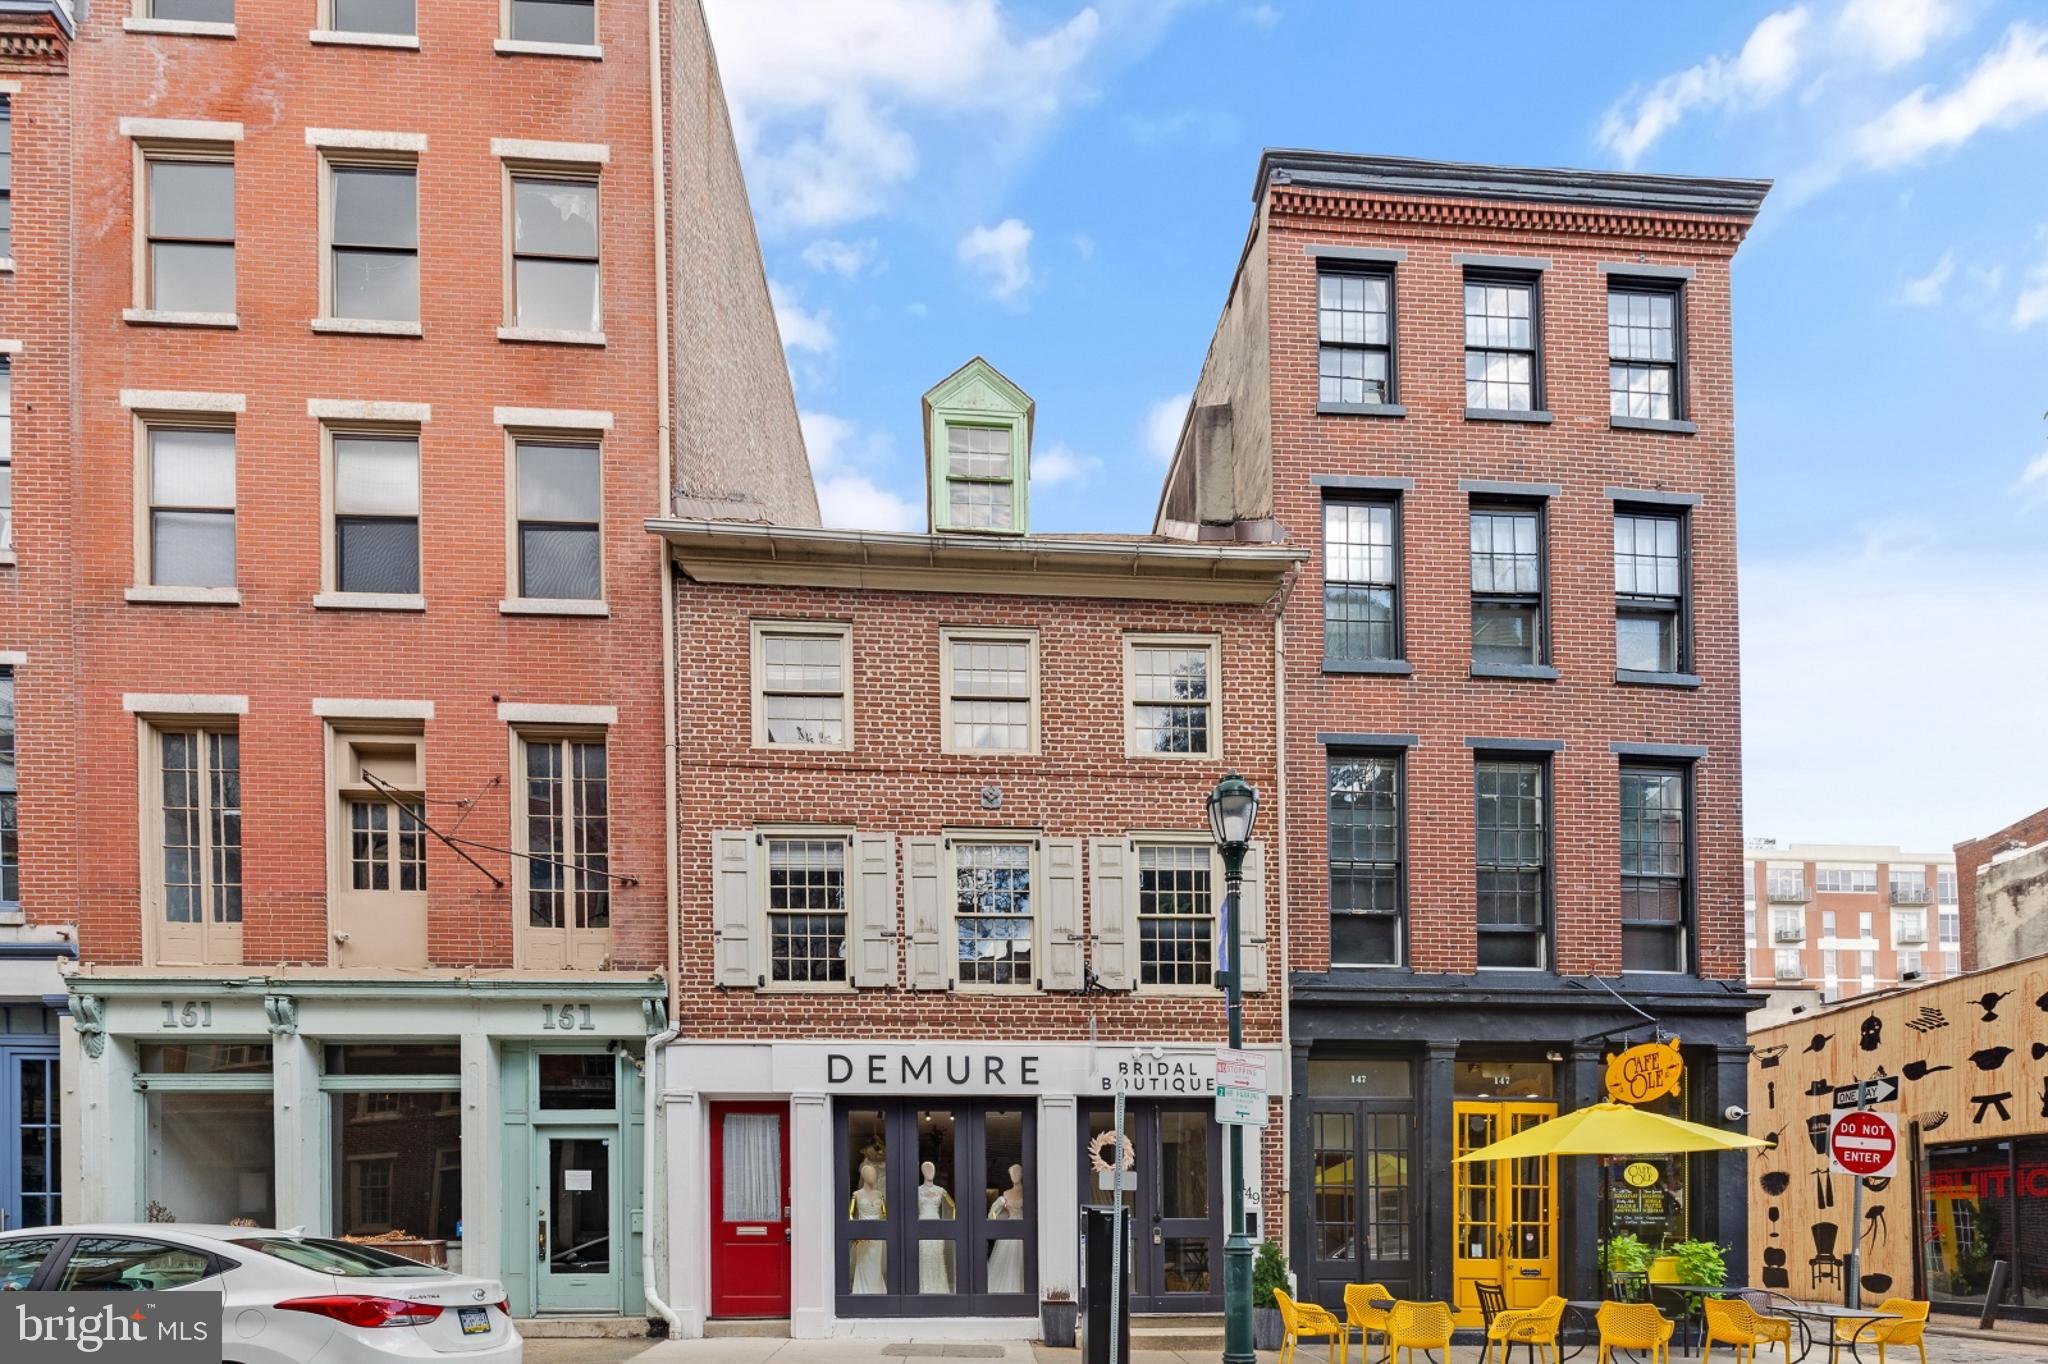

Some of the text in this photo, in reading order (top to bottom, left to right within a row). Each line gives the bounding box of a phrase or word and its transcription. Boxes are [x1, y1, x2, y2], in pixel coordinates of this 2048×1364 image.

[161, 1000, 212, 1028] 151
[542, 1003, 596, 1030] 151
[827, 1054, 1040, 1085] DEMURE
[1119, 1062, 1198, 1076] BRIDAL
[1623, 1052, 1660, 1083] CAFE
[1351, 1075, 1367, 1084] 147
[1494, 1076, 1511, 1085] 147
[1839, 1090, 1857, 1103] ONE
[1840, 1122, 1887, 1136] DO NOT
[1843, 1150, 1881, 1164] ENTER
